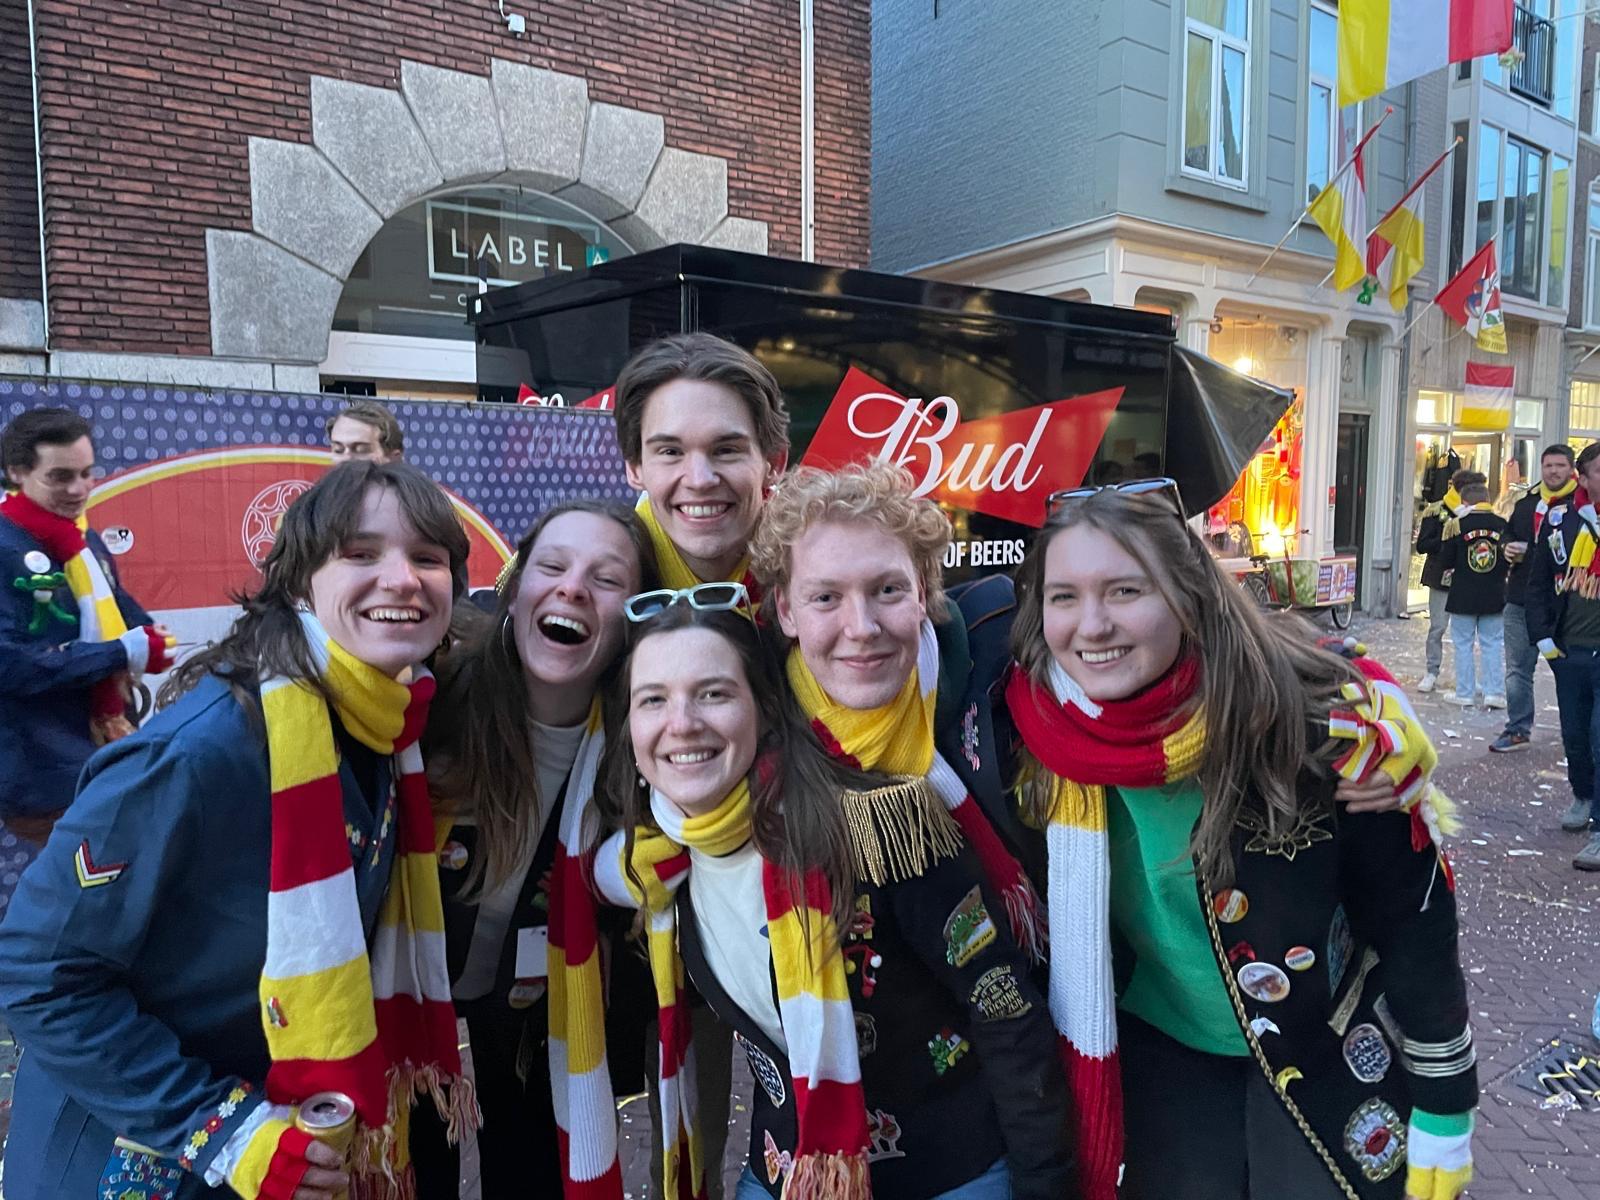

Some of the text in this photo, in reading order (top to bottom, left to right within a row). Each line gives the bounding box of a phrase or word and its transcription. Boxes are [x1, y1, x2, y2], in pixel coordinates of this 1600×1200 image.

[451, 227, 574, 272] LABEL
[846, 392, 1054, 499] Bud
[943, 538, 1026, 568] OF BEERS
